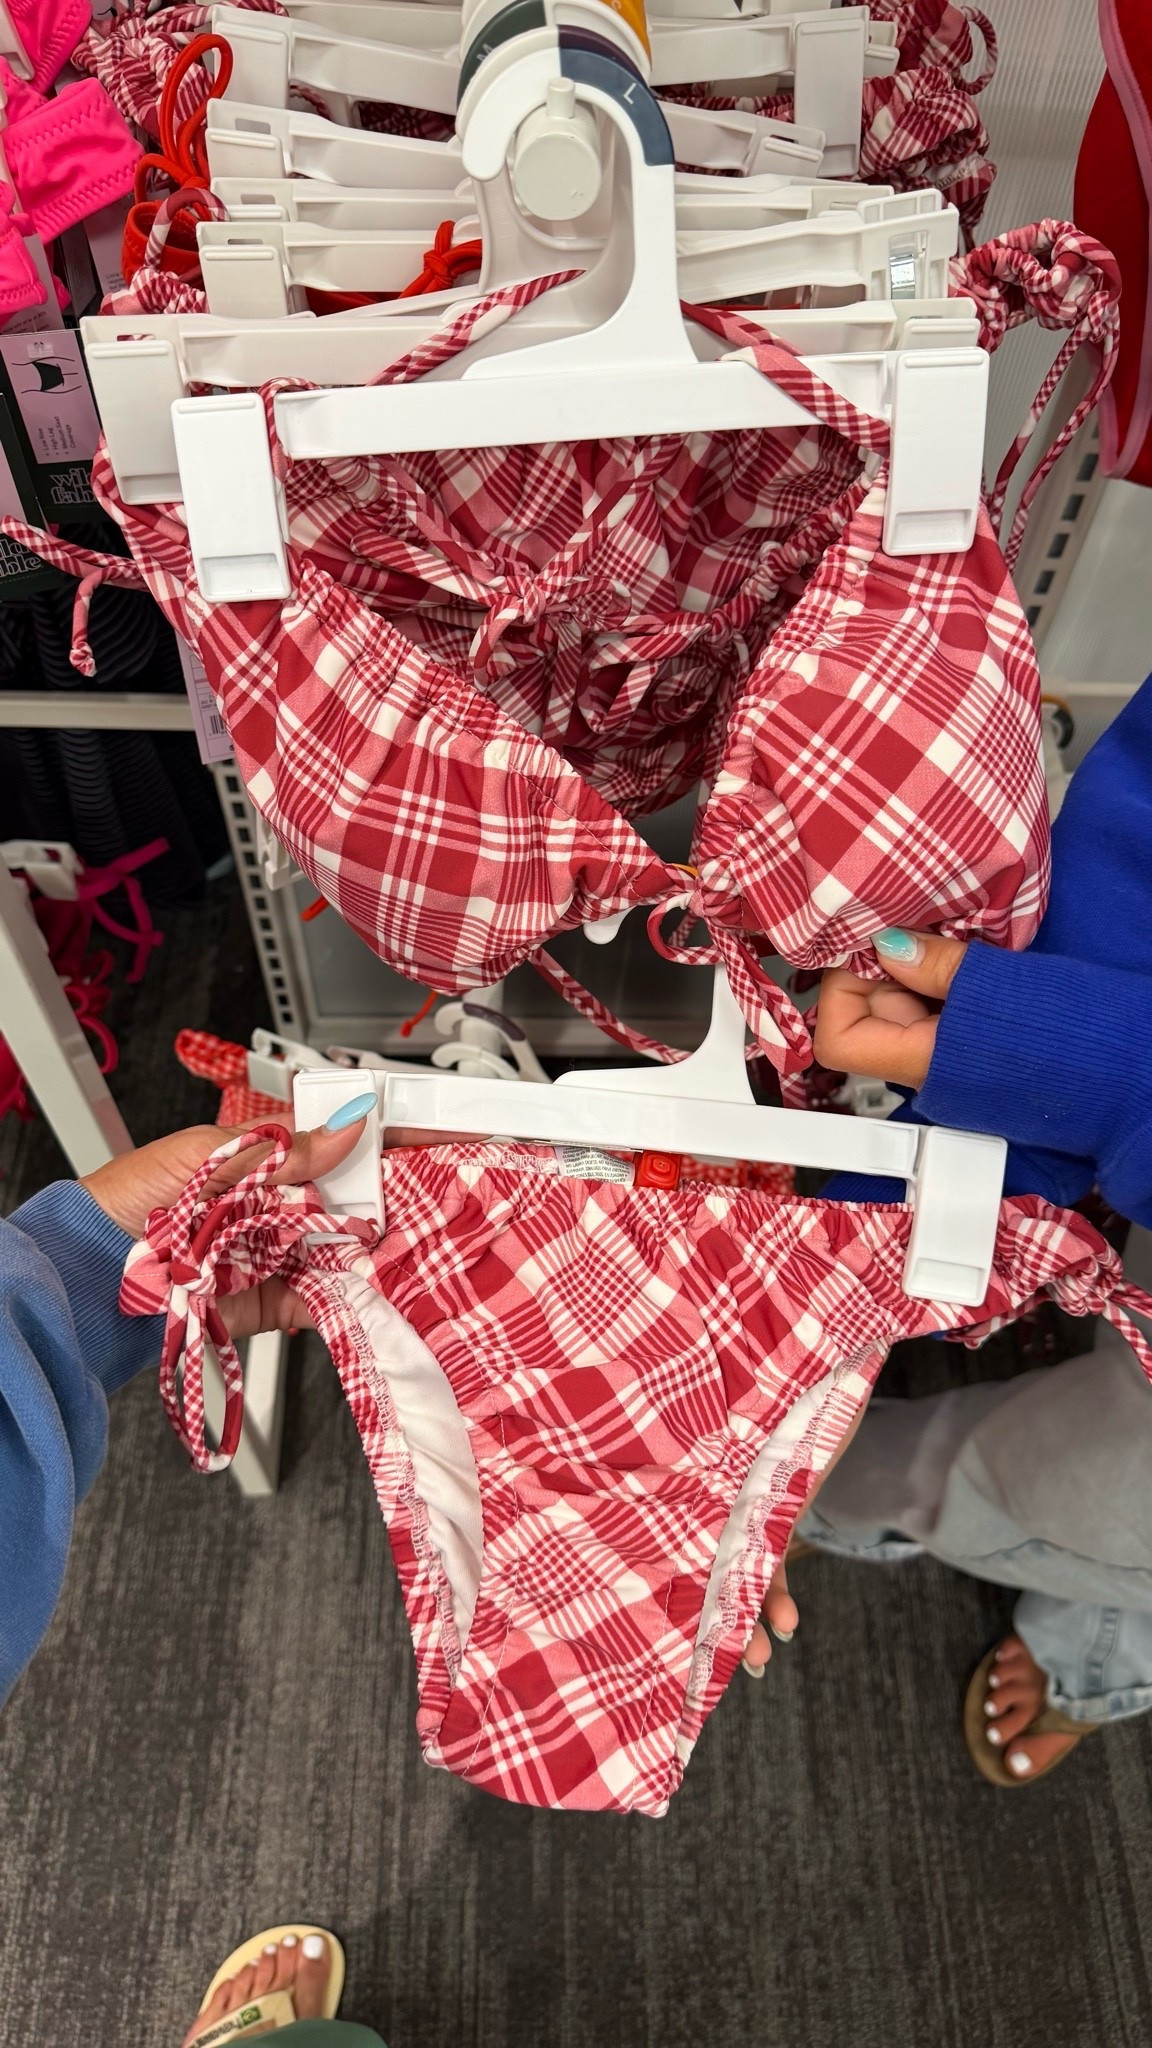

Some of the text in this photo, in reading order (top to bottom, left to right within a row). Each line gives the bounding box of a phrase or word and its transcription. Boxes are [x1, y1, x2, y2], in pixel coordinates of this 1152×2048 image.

[622, 82, 637, 105] L
[50, 467, 91, 487] wil
[50, 486, 97, 504] fab
